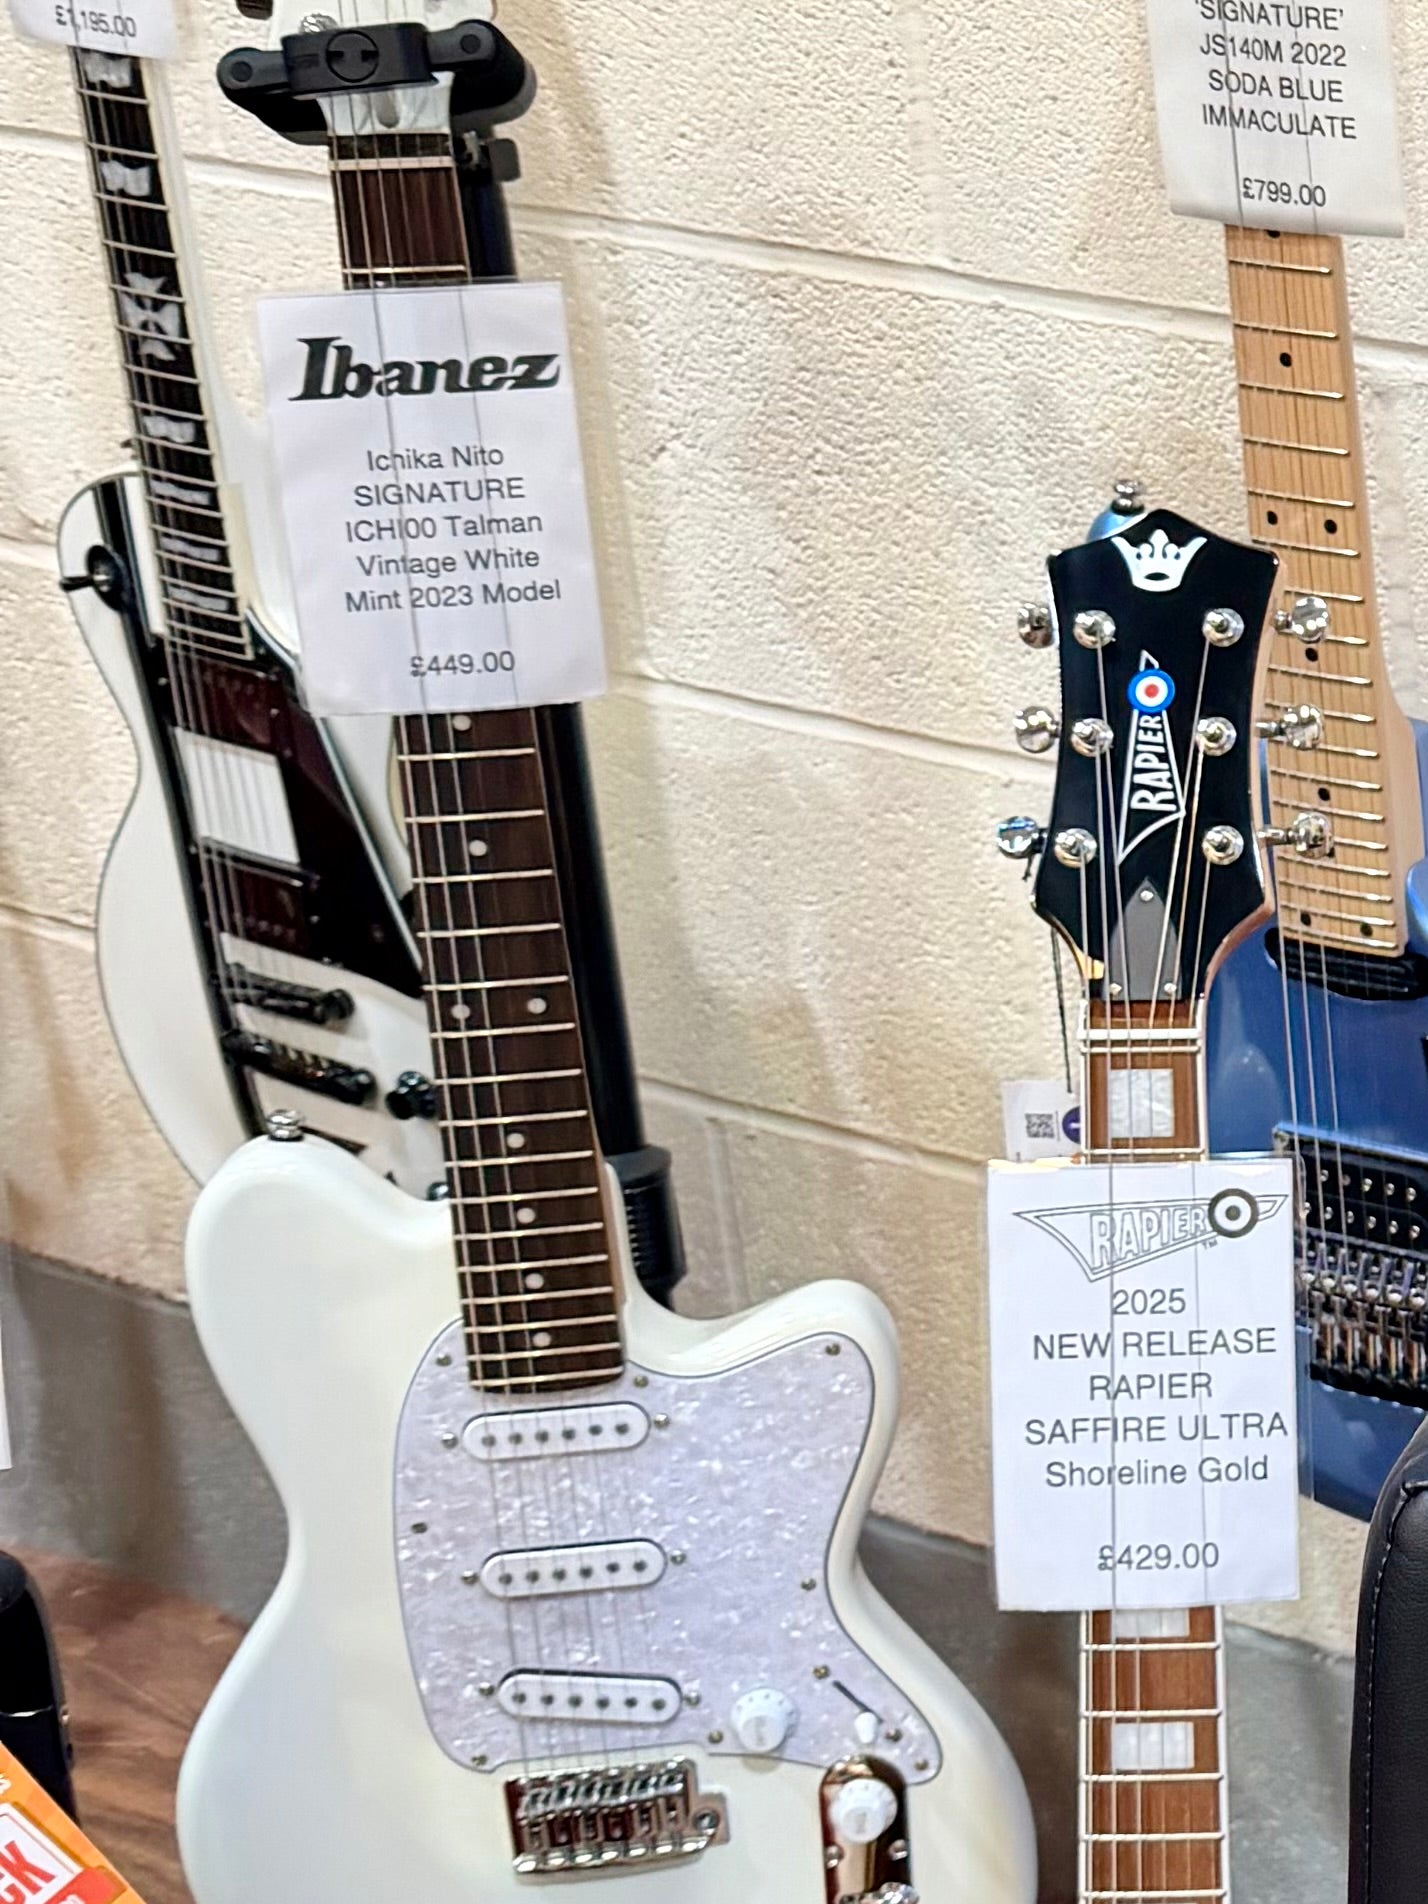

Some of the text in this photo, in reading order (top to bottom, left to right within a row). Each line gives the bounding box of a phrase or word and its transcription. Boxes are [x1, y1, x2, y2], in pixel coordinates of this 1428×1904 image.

[55, 4, 137, 38] £1,195.00
[1199, 32, 1347, 68] JS140M 2022
[1208, 68, 1344, 103] SODA BLUE
[1202, 103, 1358, 140] IMMACULATE
[1243, 177, 1327, 207] £799.00
[288, 336, 561, 402] Ibanez
[367, 445, 505, 473] Ichika Nito
[353, 477, 527, 507] SIGNATURE
[444, 514, 543, 538] Talman
[357, 547, 540, 579] Vintage White
[345, 579, 562, 613] Mint 2023 Model
[410, 650, 516, 678] £449.00
[1130, 715, 1178, 812] RAPIER
[1088, 1206, 1208, 1270] RAPIER
[1110, 1288, 1187, 1317] 2025
[1032, 1327, 1278, 1361] NEW RELEASE
[1089, 1371, 1214, 1402] RAPIER
[1024, 1412, 1289, 1446] SAFFIRE ULTRA
[1045, 1454, 1270, 1488] Shoreline Gold
[1097, 1541, 1221, 1573] £429.00
